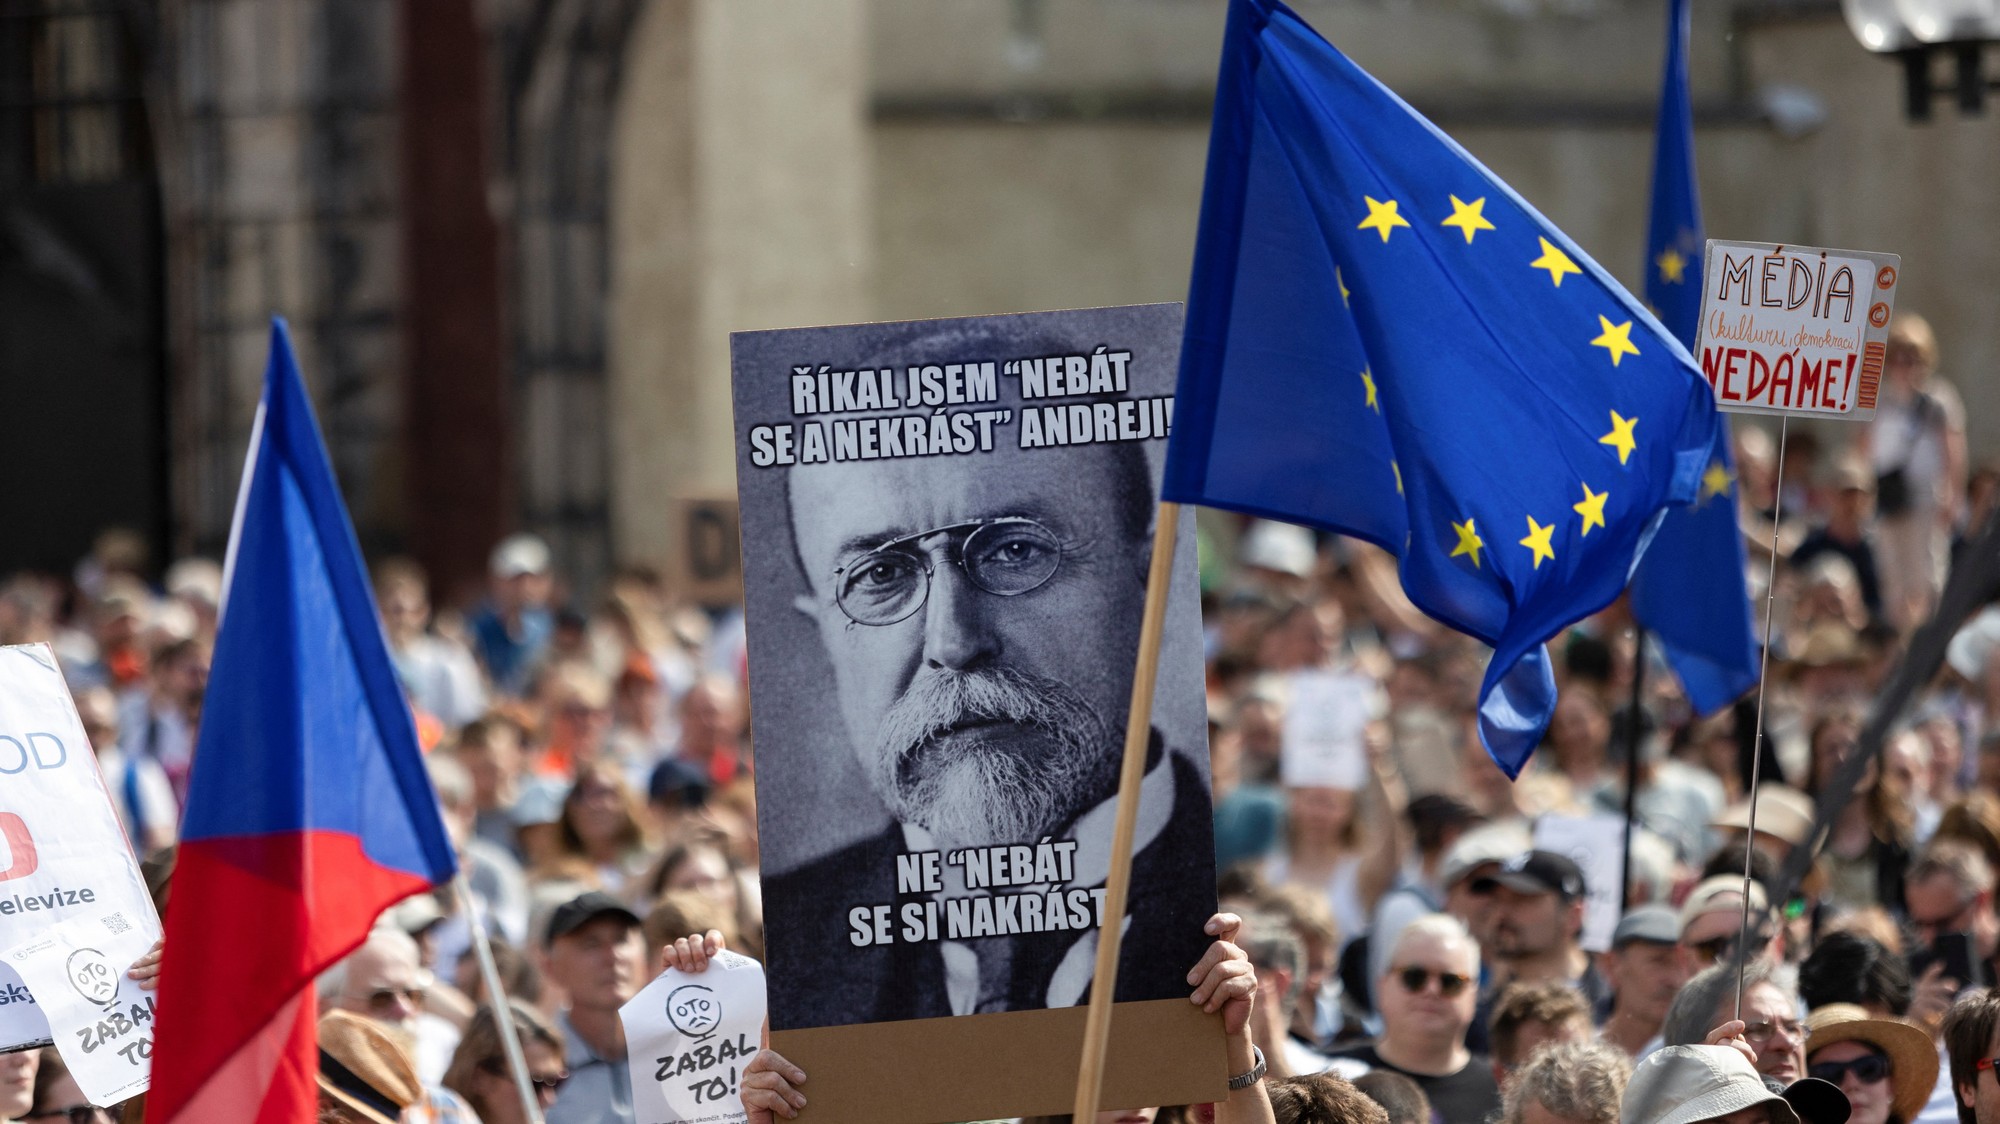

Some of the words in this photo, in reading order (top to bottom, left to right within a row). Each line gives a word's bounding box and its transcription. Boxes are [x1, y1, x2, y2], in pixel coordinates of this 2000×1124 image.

[1718, 245, 1854, 323] MÉDIA
[792, 364, 899, 415] ŘÍKAL
[906, 361, 996, 407] JSEM
[1702, 347, 1858, 411] NEDÁME!
[750, 425, 793, 467] SE
[802, 422, 828, 463] A
[1020, 397, 1176, 448] ANDREJI!
[897, 852, 942, 893] NE
[849, 905, 893, 946] SE
[900, 902, 938, 942] SI
[946, 885, 1109, 939] NAKRÁST
[676, 998, 711, 1017] OTO
[117, 1027, 155, 1066] TO
[655, 1034, 757, 1082] ZABAL
[688, 1066, 736, 1104] TO!
